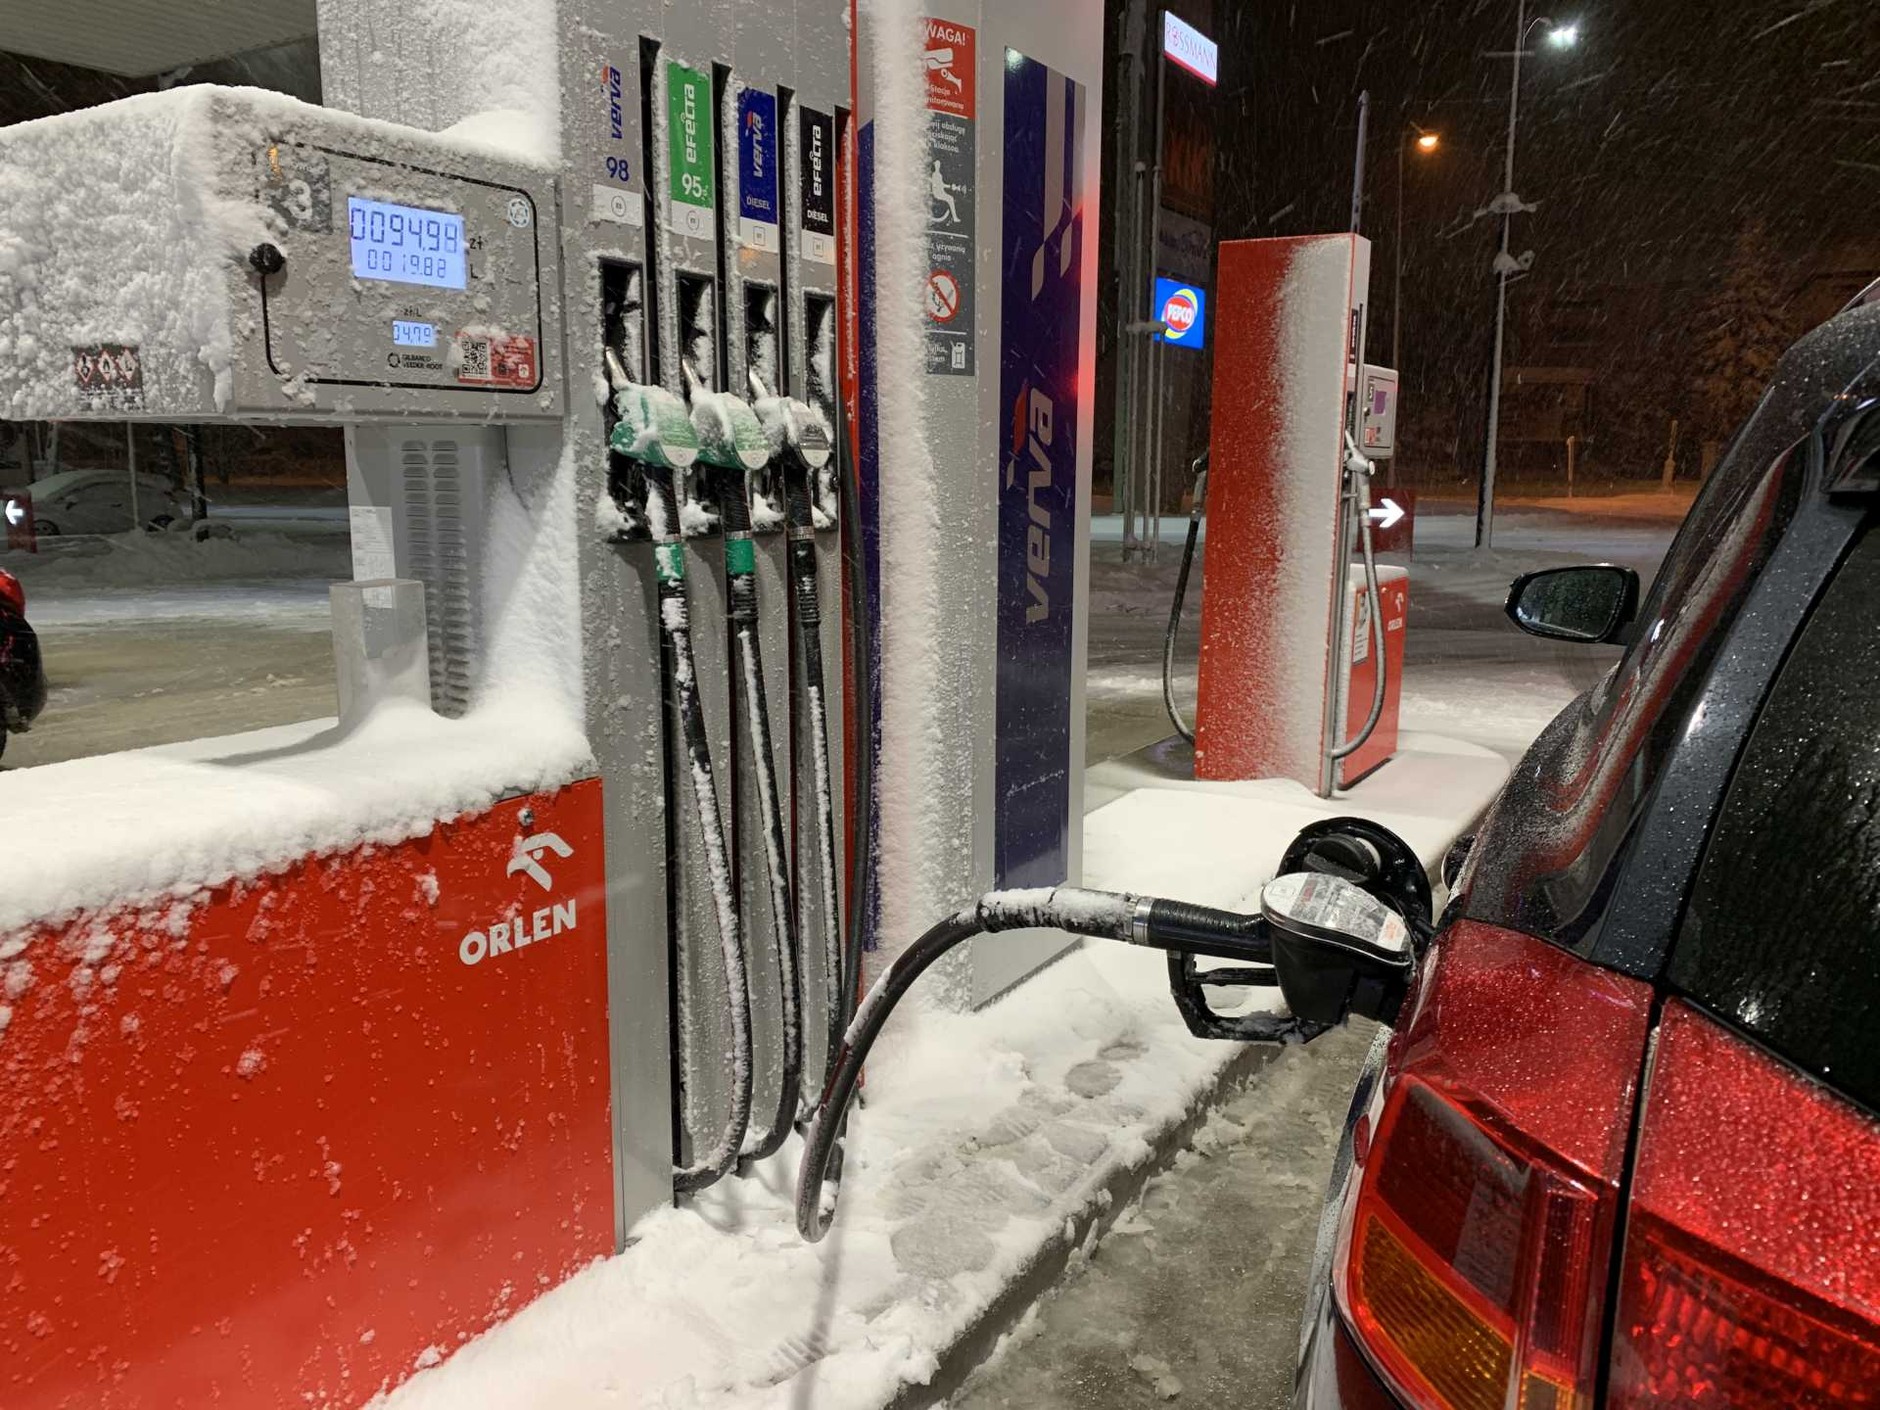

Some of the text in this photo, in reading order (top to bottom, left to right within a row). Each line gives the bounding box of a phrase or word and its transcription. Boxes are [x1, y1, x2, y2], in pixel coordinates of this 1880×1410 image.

[924, 22, 966, 46] WAGA!
[609, 66, 622, 139] verva
[752, 112, 763, 178] verva
[606, 156, 630, 182] 98
[681, 173, 703, 198] 95
[288, 178, 313, 220] 3
[746, 195, 771, 210] DIESEL
[807, 209, 829, 223] DIESEL
[470, 263, 479, 279] L
[1167, 303, 1193, 324] PEPCO
[1026, 386, 1054, 626] verva
[458, 898, 577, 966] ORLEN
